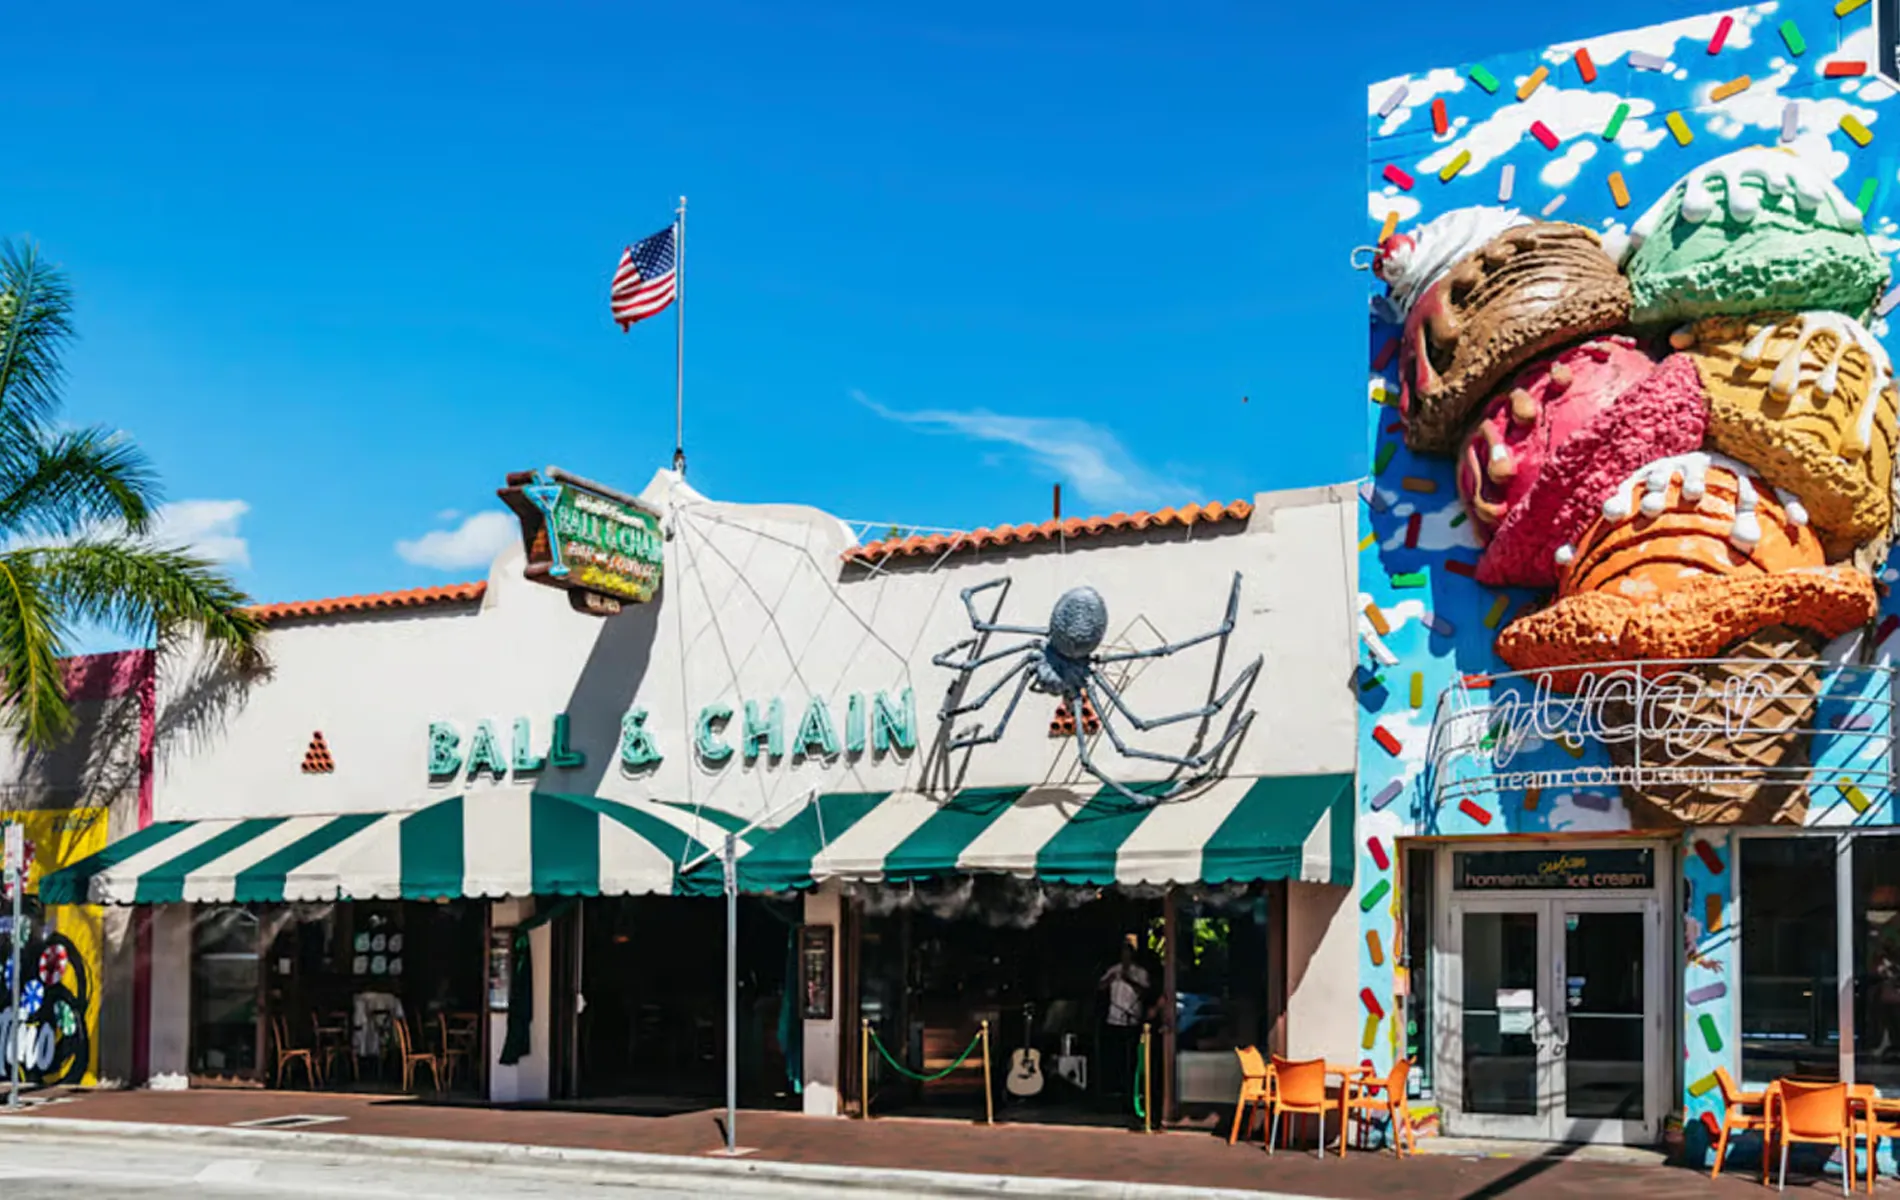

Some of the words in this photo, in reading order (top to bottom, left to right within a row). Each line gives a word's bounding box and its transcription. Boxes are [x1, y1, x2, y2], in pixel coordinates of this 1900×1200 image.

[558, 505, 602, 545] BALL
[428, 711, 587, 775] BALL
[620, 704, 665, 765] &
[694, 686, 917, 760] CHAIN
[1592, 871, 1647, 888] cream
